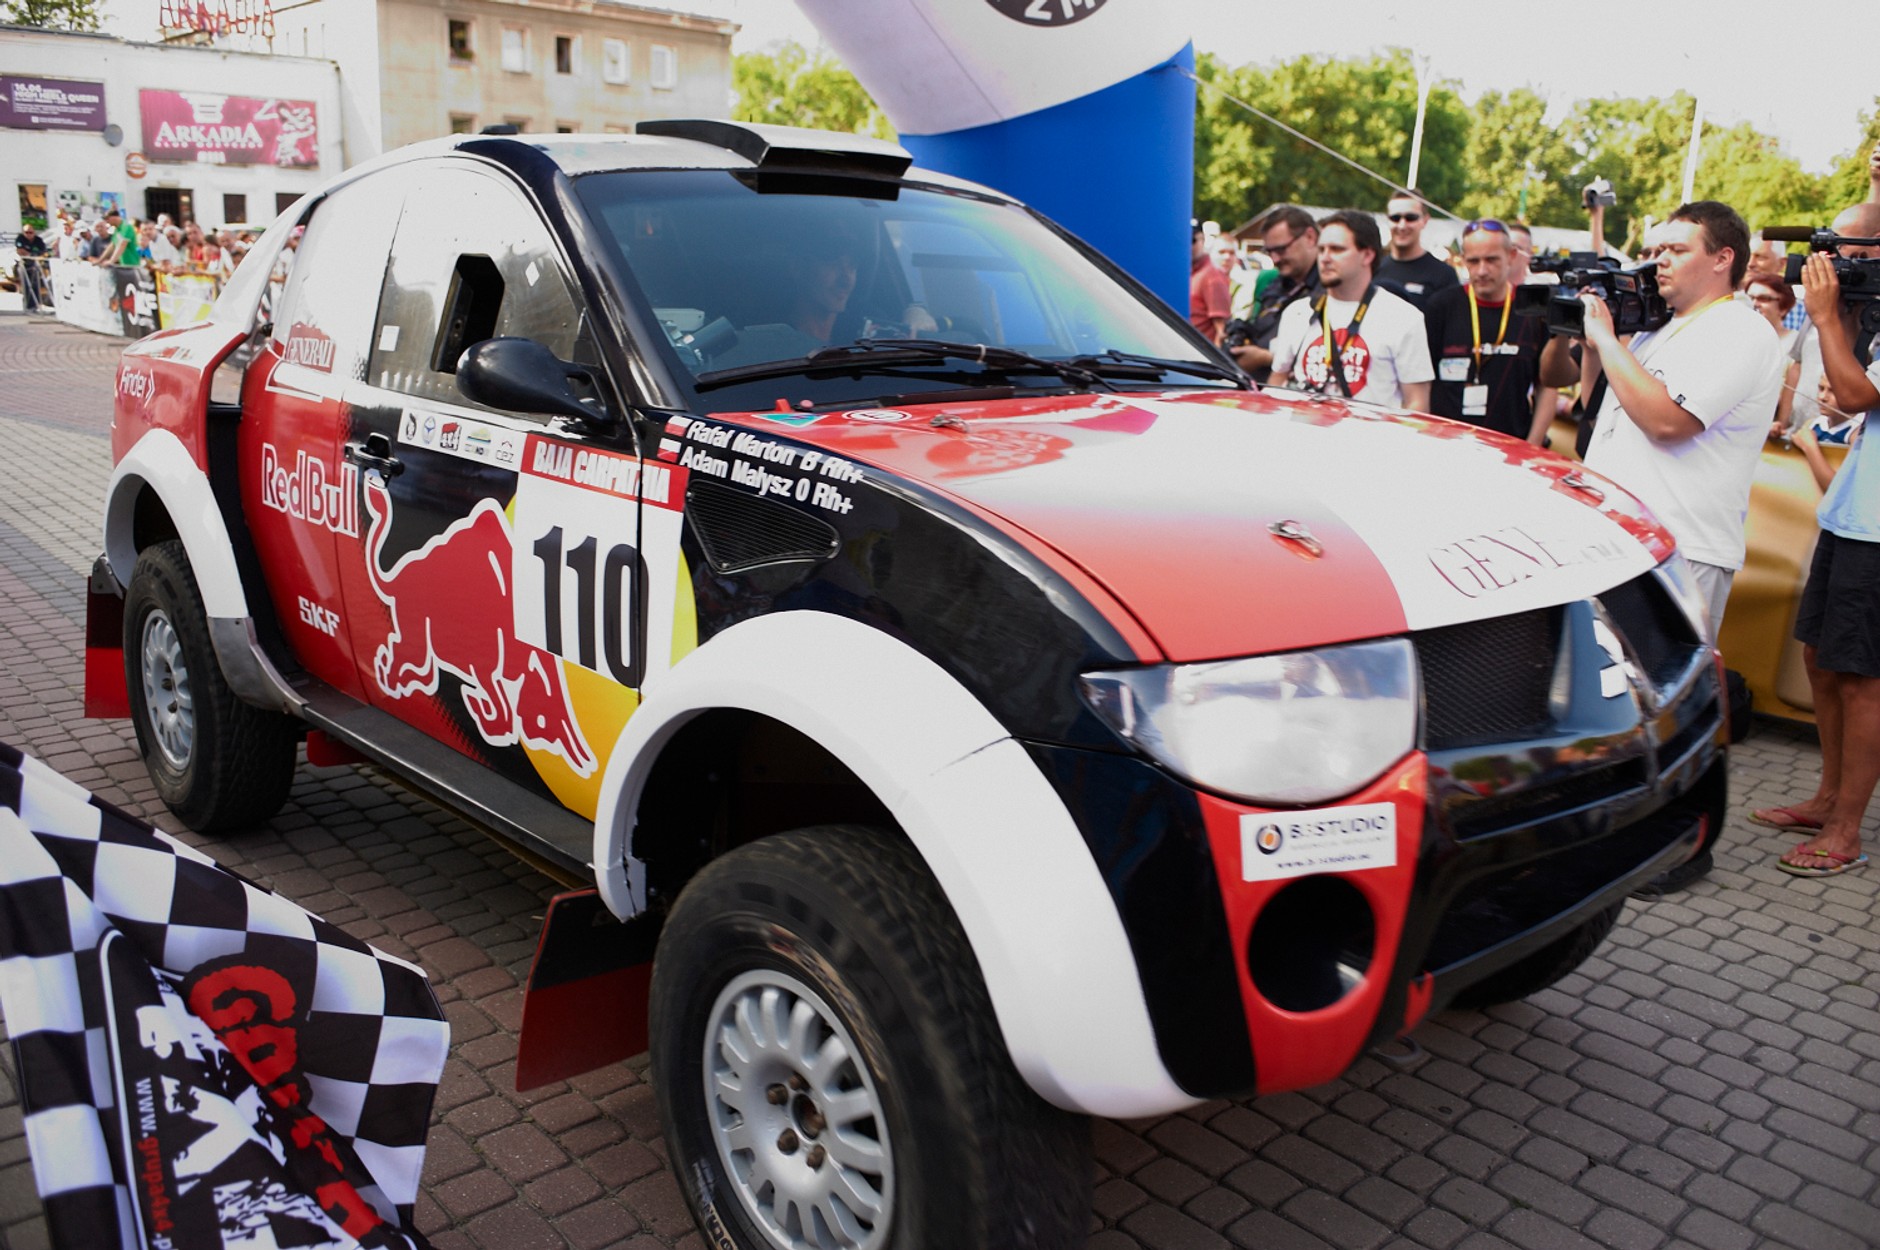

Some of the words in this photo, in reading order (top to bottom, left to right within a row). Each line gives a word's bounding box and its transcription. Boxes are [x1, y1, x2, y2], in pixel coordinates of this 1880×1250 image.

[155, 121, 263, 144] ARKADIA
[119, 365, 147, 398] Finder
[532, 440, 574, 480] BAJA
[679, 446, 728, 478] Adam
[811, 482, 854, 515] Rh+
[731, 432, 797, 466] Marton
[820, 456, 864, 485] Rh+
[298, 595, 340, 638] SKF
[533, 525, 649, 689] 110
[135, 1076, 177, 1250] www.grupa4x4.p
